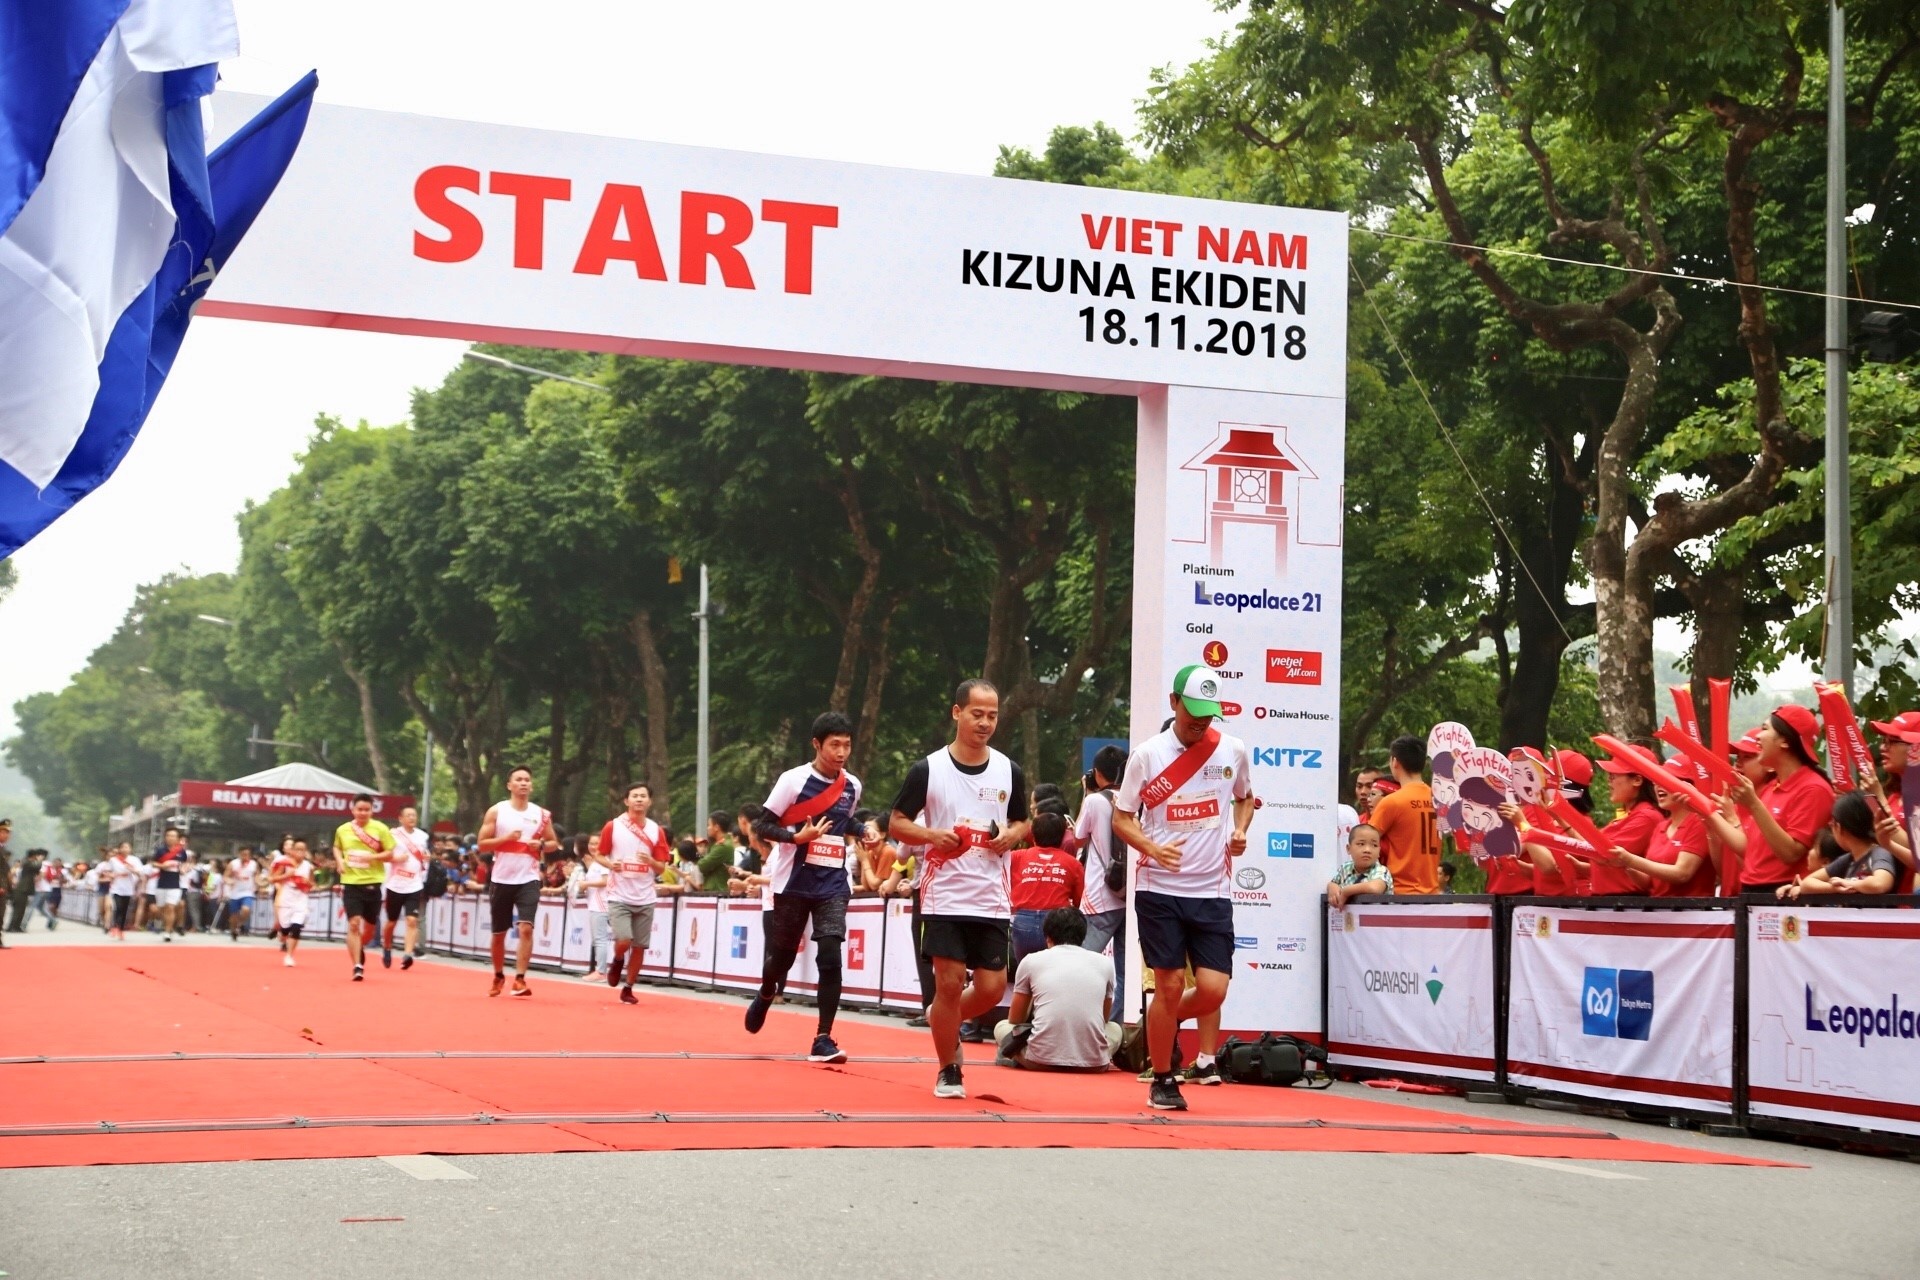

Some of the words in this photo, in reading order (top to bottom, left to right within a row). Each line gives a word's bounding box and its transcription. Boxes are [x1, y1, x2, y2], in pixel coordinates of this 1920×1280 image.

[413, 164, 839, 295] START
[1081, 213, 1183, 257] VIET
[1198, 225, 1308, 270] NAM
[962, 248, 1136, 300] KIZUNA
[1151, 266, 1307, 316] EKIDEN
[1078, 305, 1307, 361] 18.11.2018
[1183, 563, 1235, 577] Platinum
[1194, 580, 1300, 613] Leopalace
[1302, 591, 1322, 613] 21
[1186, 622, 1213, 634] Gold
[1269, 709, 1299, 719] Daiwa
[1300, 710, 1330, 721] House
[1435, 725, 1473, 750] Fightin
[1253, 746, 1323, 769] KITZ
[1146, 776, 1173, 801] 2018
[212, 789, 262, 806] RELAY
[264, 793, 304, 808] TENT
[1267, 801, 1288, 810] Sompo
[1288, 802, 1315, 811] Holdings,
[1171, 806, 1200, 818] 1044
[1208, 803, 1215, 814] 1
[970, 833, 983, 844] 11
[812, 844, 833, 855] 1026
[837, 848, 843, 857] 1
[1232, 891, 1268, 901] TOYOTA
[1260, 963, 1292, 971] YAZAKI
[1364, 969, 1419, 995] OBAYASHI
[1621, 998, 1636, 1010] Tokyo
[1636, 999, 1652, 1010] Metro
[1806, 981, 1920, 1048] Leopala
